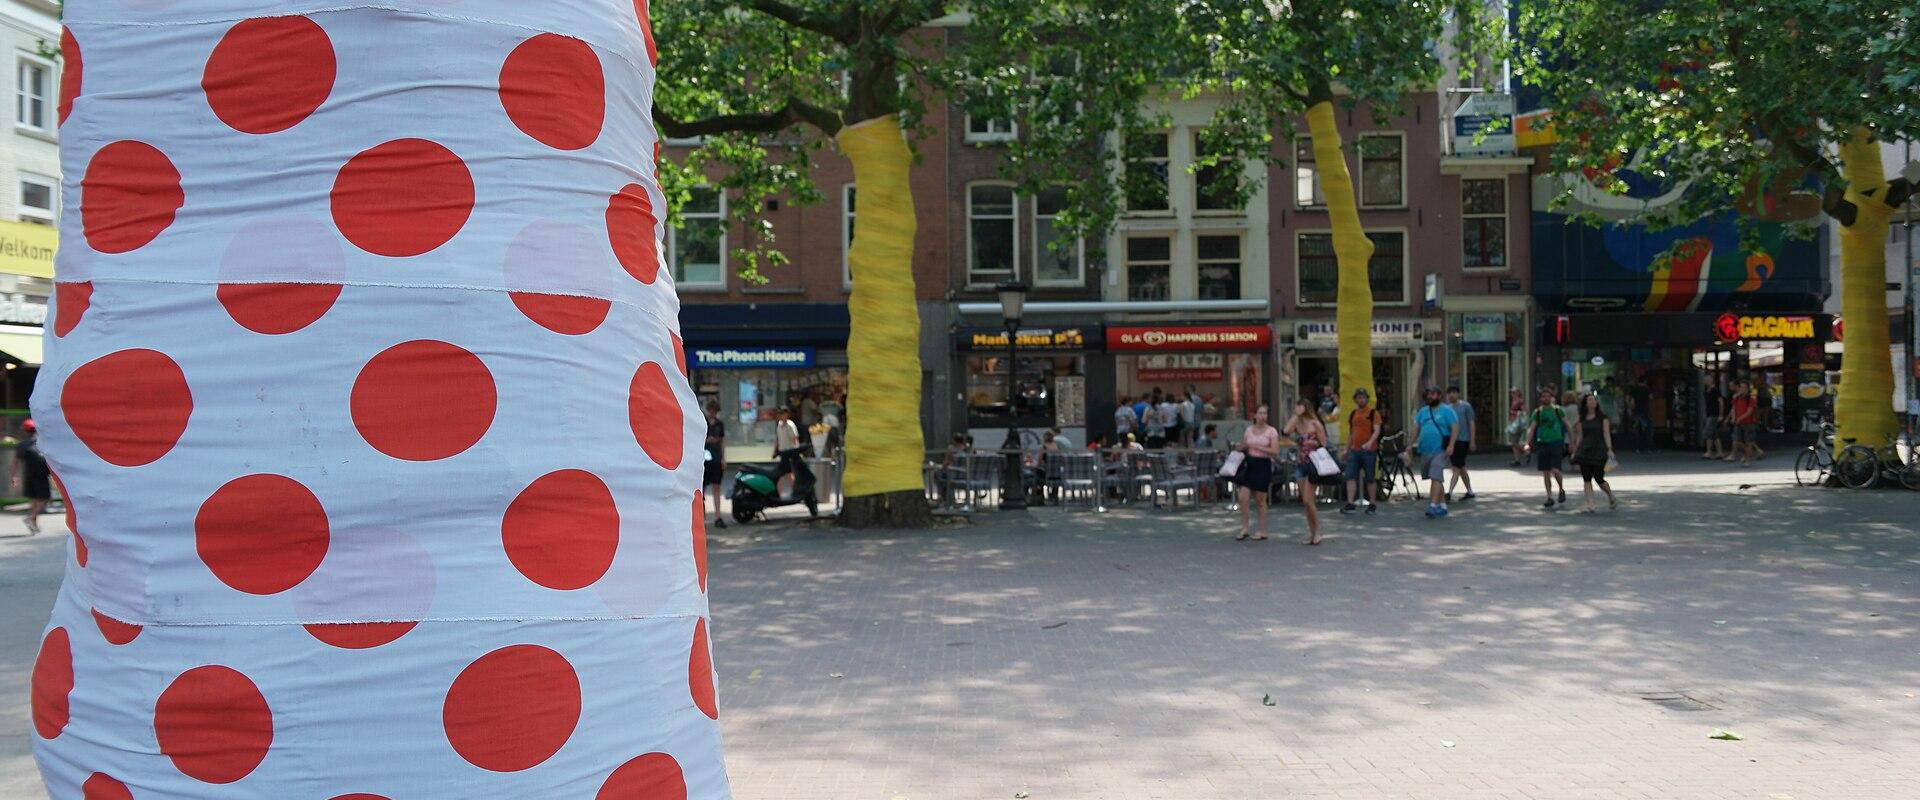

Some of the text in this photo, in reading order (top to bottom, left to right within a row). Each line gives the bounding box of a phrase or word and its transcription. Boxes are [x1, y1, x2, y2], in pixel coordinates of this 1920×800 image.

[0, 237, 52, 261] elkom
[1465, 316, 1502, 325] NOKIA
[1309, 323, 1411, 333] BLU HONE
[1120, 332, 1258, 344] OLA HAPPINESS STATION
[723, 349, 764, 362] Phone
[765, 349, 806, 362] House
